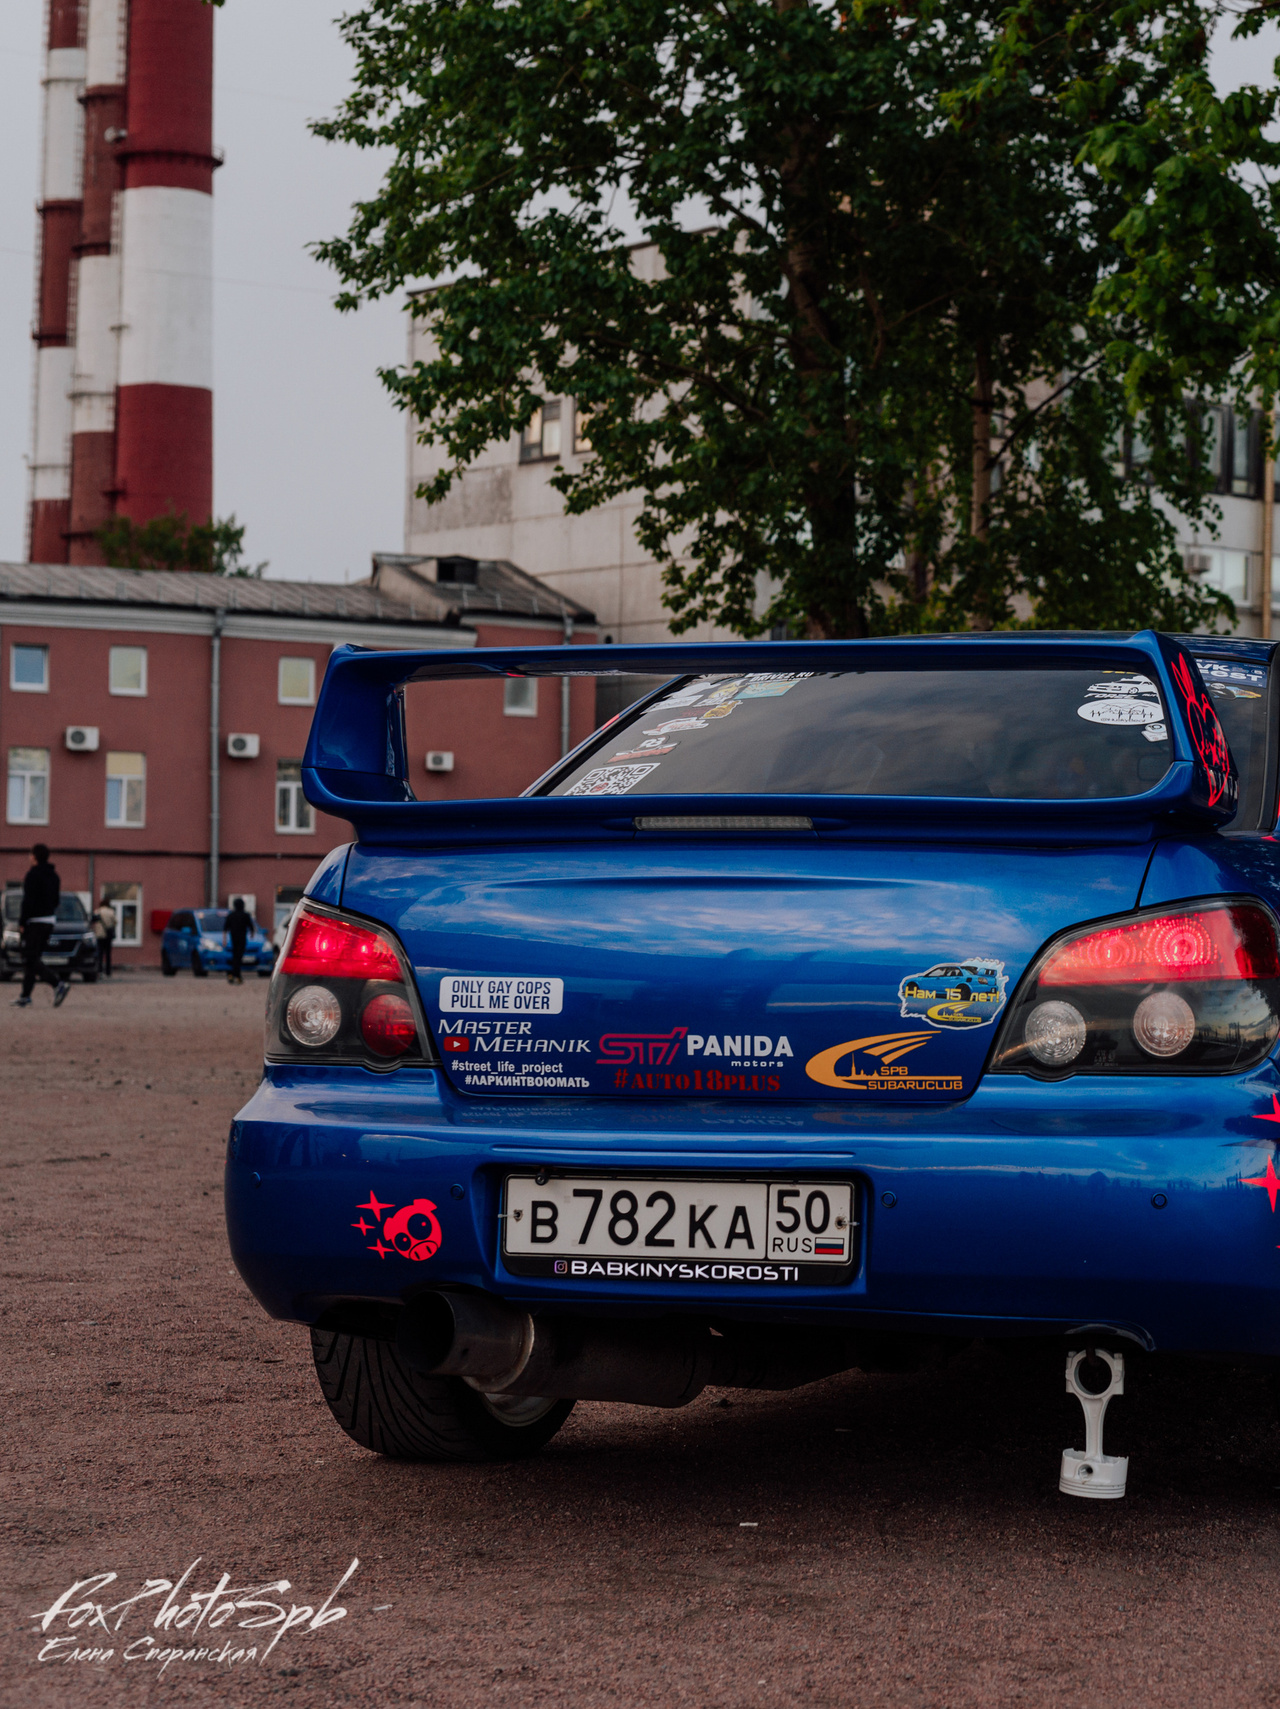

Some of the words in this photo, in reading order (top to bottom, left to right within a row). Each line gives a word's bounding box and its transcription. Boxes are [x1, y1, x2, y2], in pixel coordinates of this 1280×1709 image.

[452, 980, 484, 994] ONLY
[487, 981, 512, 994] GAY
[517, 981, 551, 995] COPS
[905, 986, 936, 999] Нам
[945, 988, 961, 1000] 15
[970, 991, 1000, 1003] лет!
[451, 995, 485, 1009] PULL
[489, 996, 510, 1009] ME
[513, 996, 550, 1010] OVER
[687, 1035, 794, 1057] PANIDA
[451, 1060, 563, 1075] #street_life_project
[731, 1060, 784, 1068] motors
[880, 1066, 908, 1075] SPB
[867, 1080, 963, 1090] SUBARUCLUB
[776, 1189, 830, 1234] 50
[772, 1237, 812, 1253] RUS
[571, 1260, 799, 1281] BABKINYSKOROSTI
